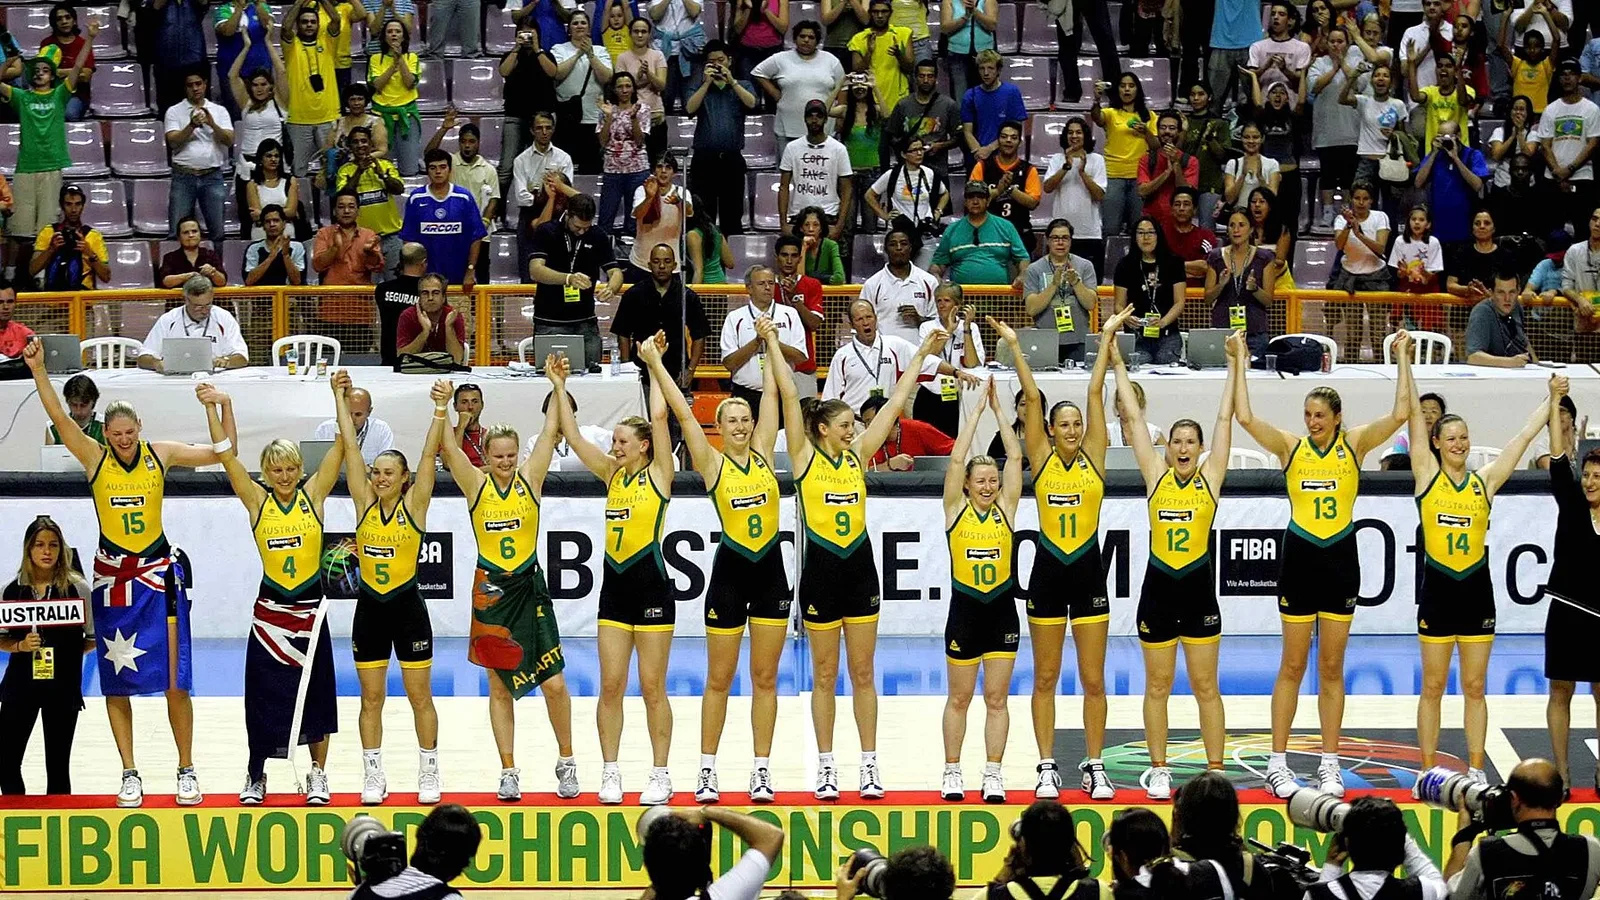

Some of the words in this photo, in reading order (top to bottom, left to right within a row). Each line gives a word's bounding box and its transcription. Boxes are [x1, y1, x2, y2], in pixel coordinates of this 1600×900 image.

[1001, 203, 1012, 217] 3
[422, 223, 460, 233] ARCOR
[384, 291, 420, 305] SEGURAN
[105, 482, 158, 491] AUSTRALIA
[1044, 479, 1091, 490] AUSTRALIA
[480, 506, 531, 519] AUSTRALIA
[1155, 497, 1205, 506] AUSTRALIA
[1313, 496, 1337, 520] 13
[122, 512, 145, 535] 15
[262, 521, 312, 535] AUSTRALIA
[748, 514, 763, 539] 8
[835, 511, 850, 536] 9
[1059, 513, 1076, 538] 11
[361, 530, 407, 543] AUSTRALIA
[612, 527, 624, 552] 7
[958, 530, 1005, 541] AUSTRALIA
[1166, 528, 1190, 552] 12
[1446, 532, 1470, 556] 14
[500, 537, 516, 560] 6
[1230, 538, 1277, 560] FIBA
[282, 556, 296, 579] 4
[375, 563, 390, 585] 5
[972, 563, 996, 585] 10
[1250, 579, 1277, 587] Basketba
[0, 604, 81, 624] USTRALIA
[4, 813, 161, 886] FIBA
